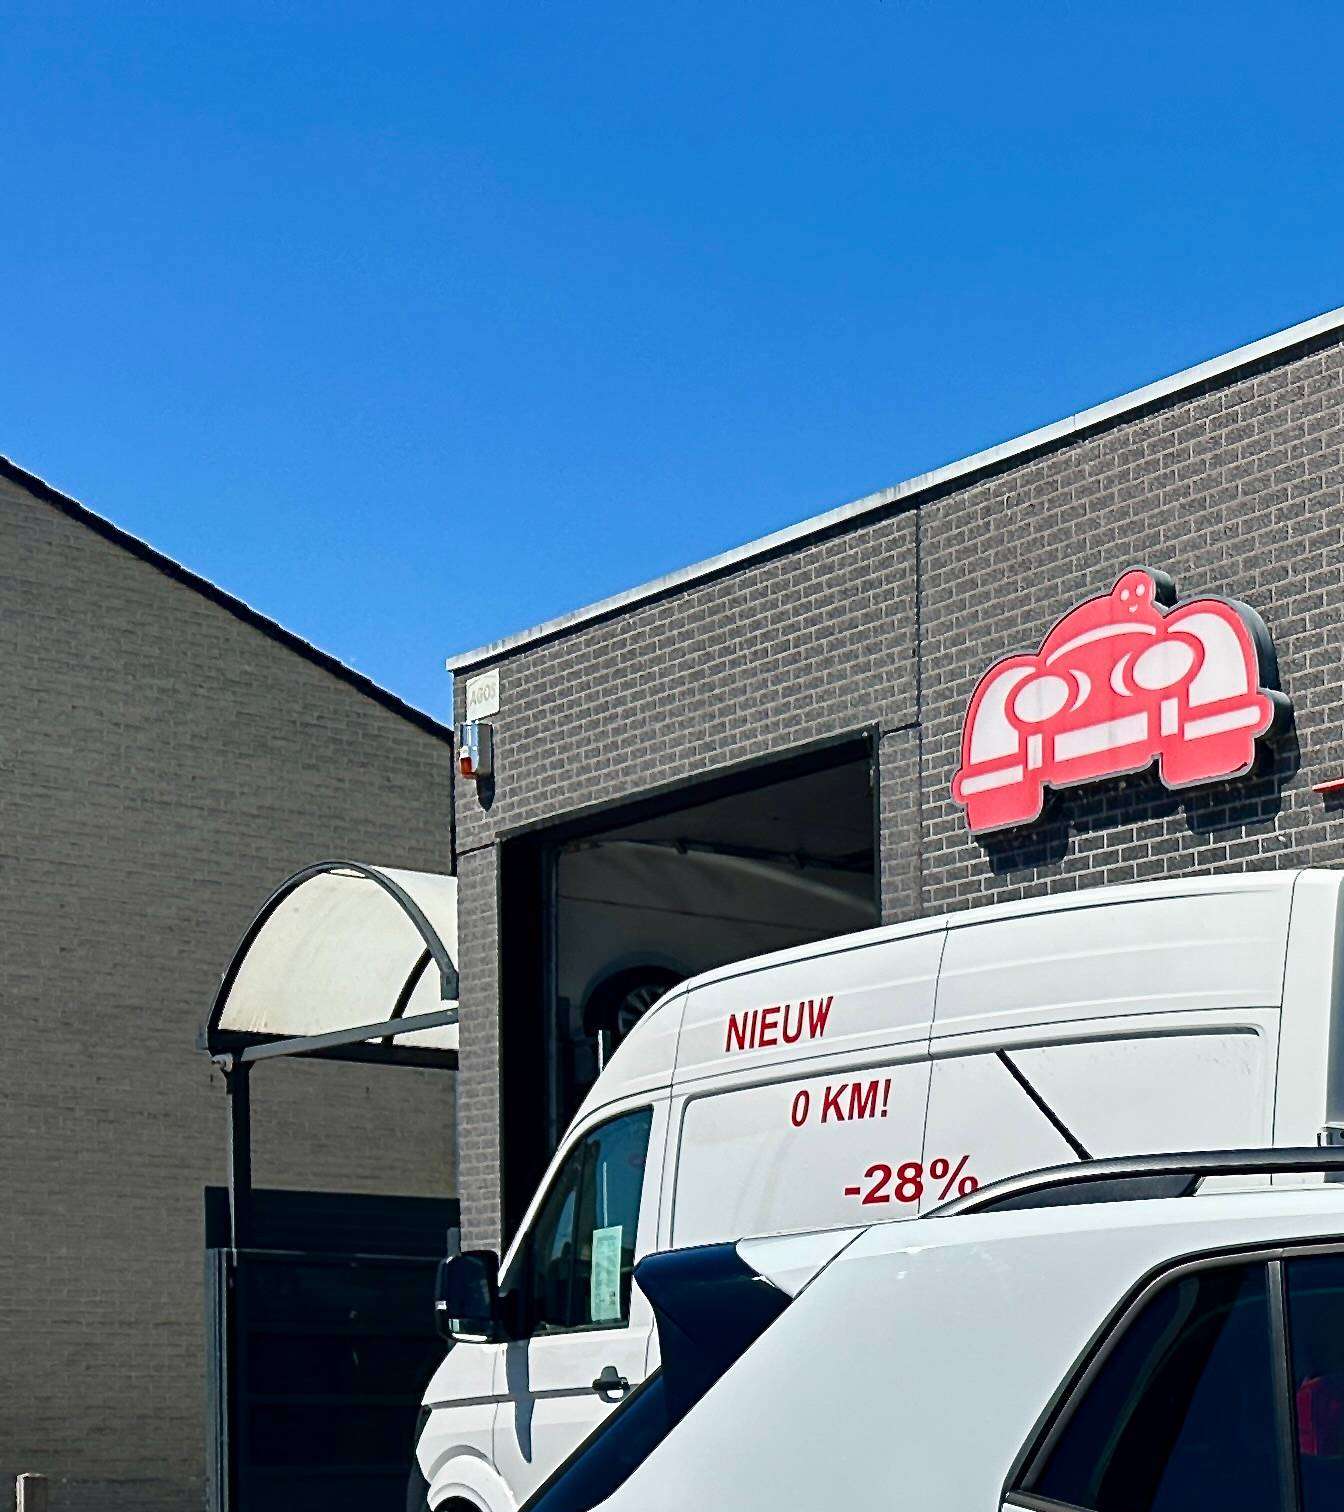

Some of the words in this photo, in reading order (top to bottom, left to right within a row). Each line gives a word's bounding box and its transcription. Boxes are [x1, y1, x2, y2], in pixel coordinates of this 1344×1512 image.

[724, 996, 834, 1052] NIEUW
[790, 1090, 811, 1127] 0
[820, 1078, 892, 1125] KM!
[843, 1154, 979, 1206] -28%
